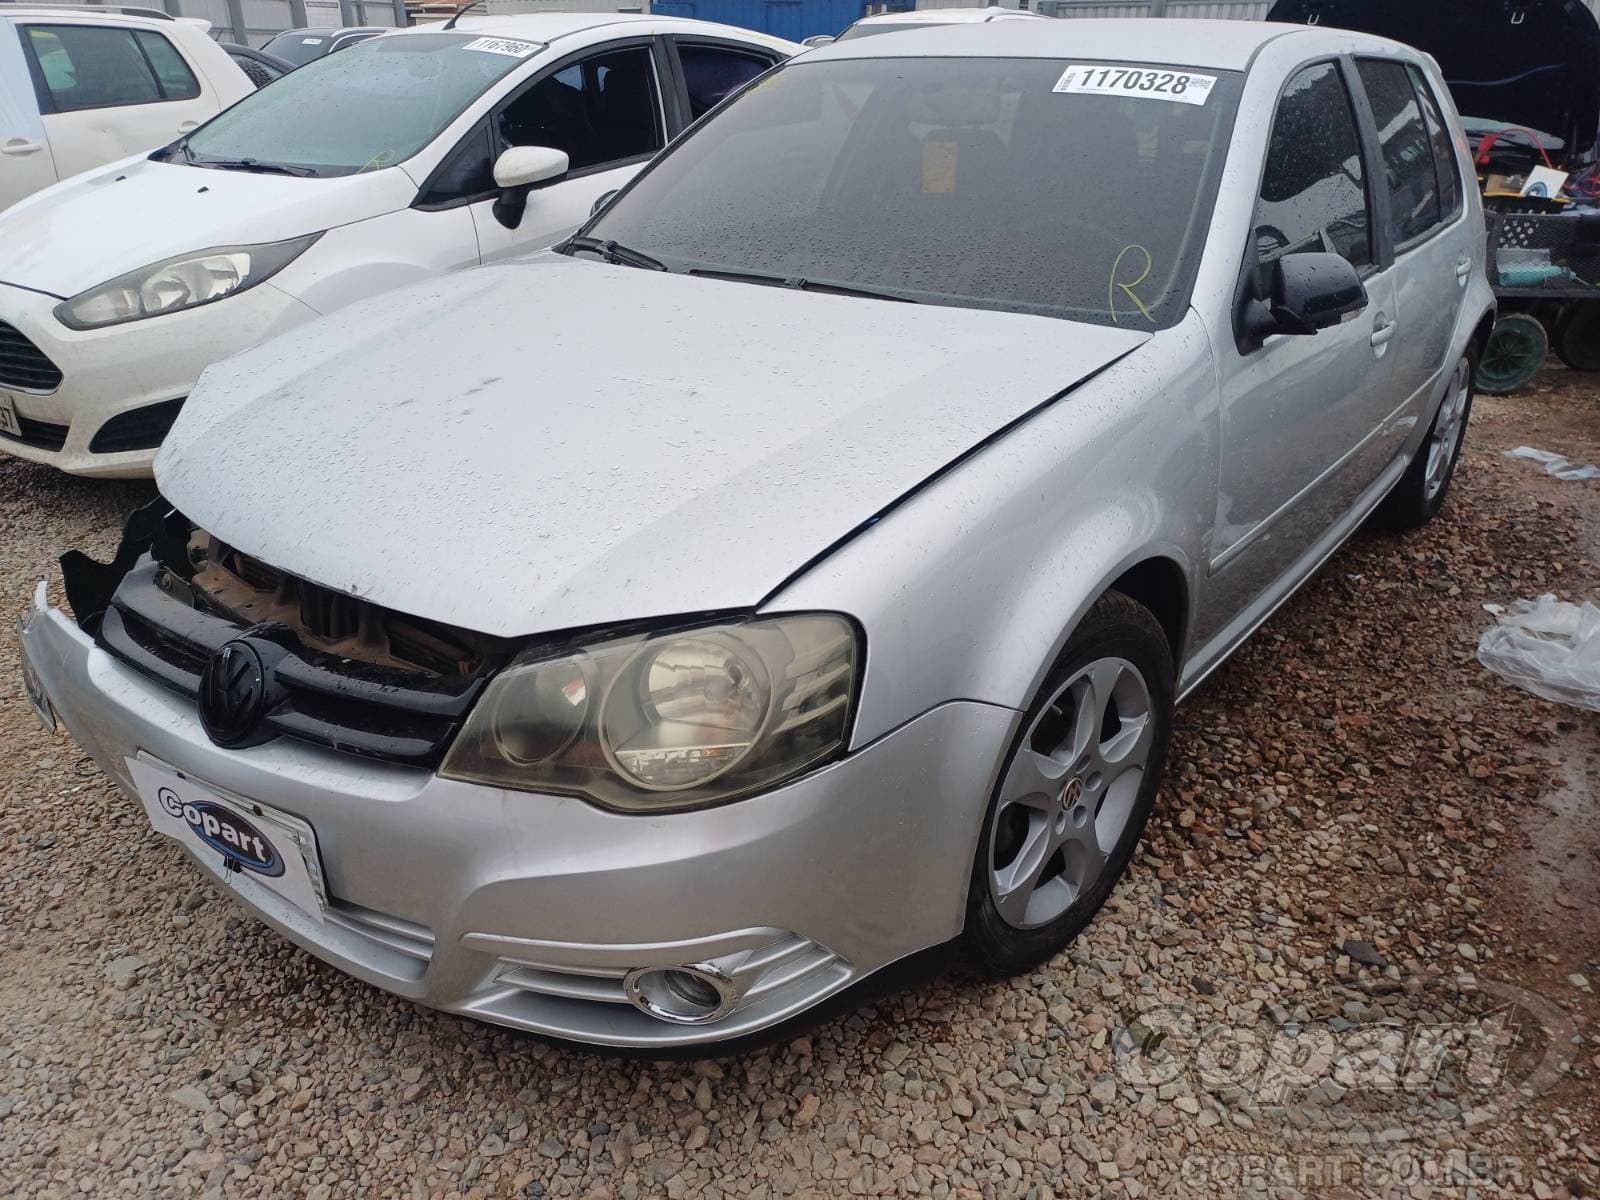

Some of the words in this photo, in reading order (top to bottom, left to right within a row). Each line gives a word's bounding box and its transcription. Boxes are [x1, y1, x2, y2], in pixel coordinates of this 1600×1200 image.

[1081, 68, 1191, 95] 1170328
[1109, 244, 1157, 324] R
[157, 786, 268, 864] Copart
